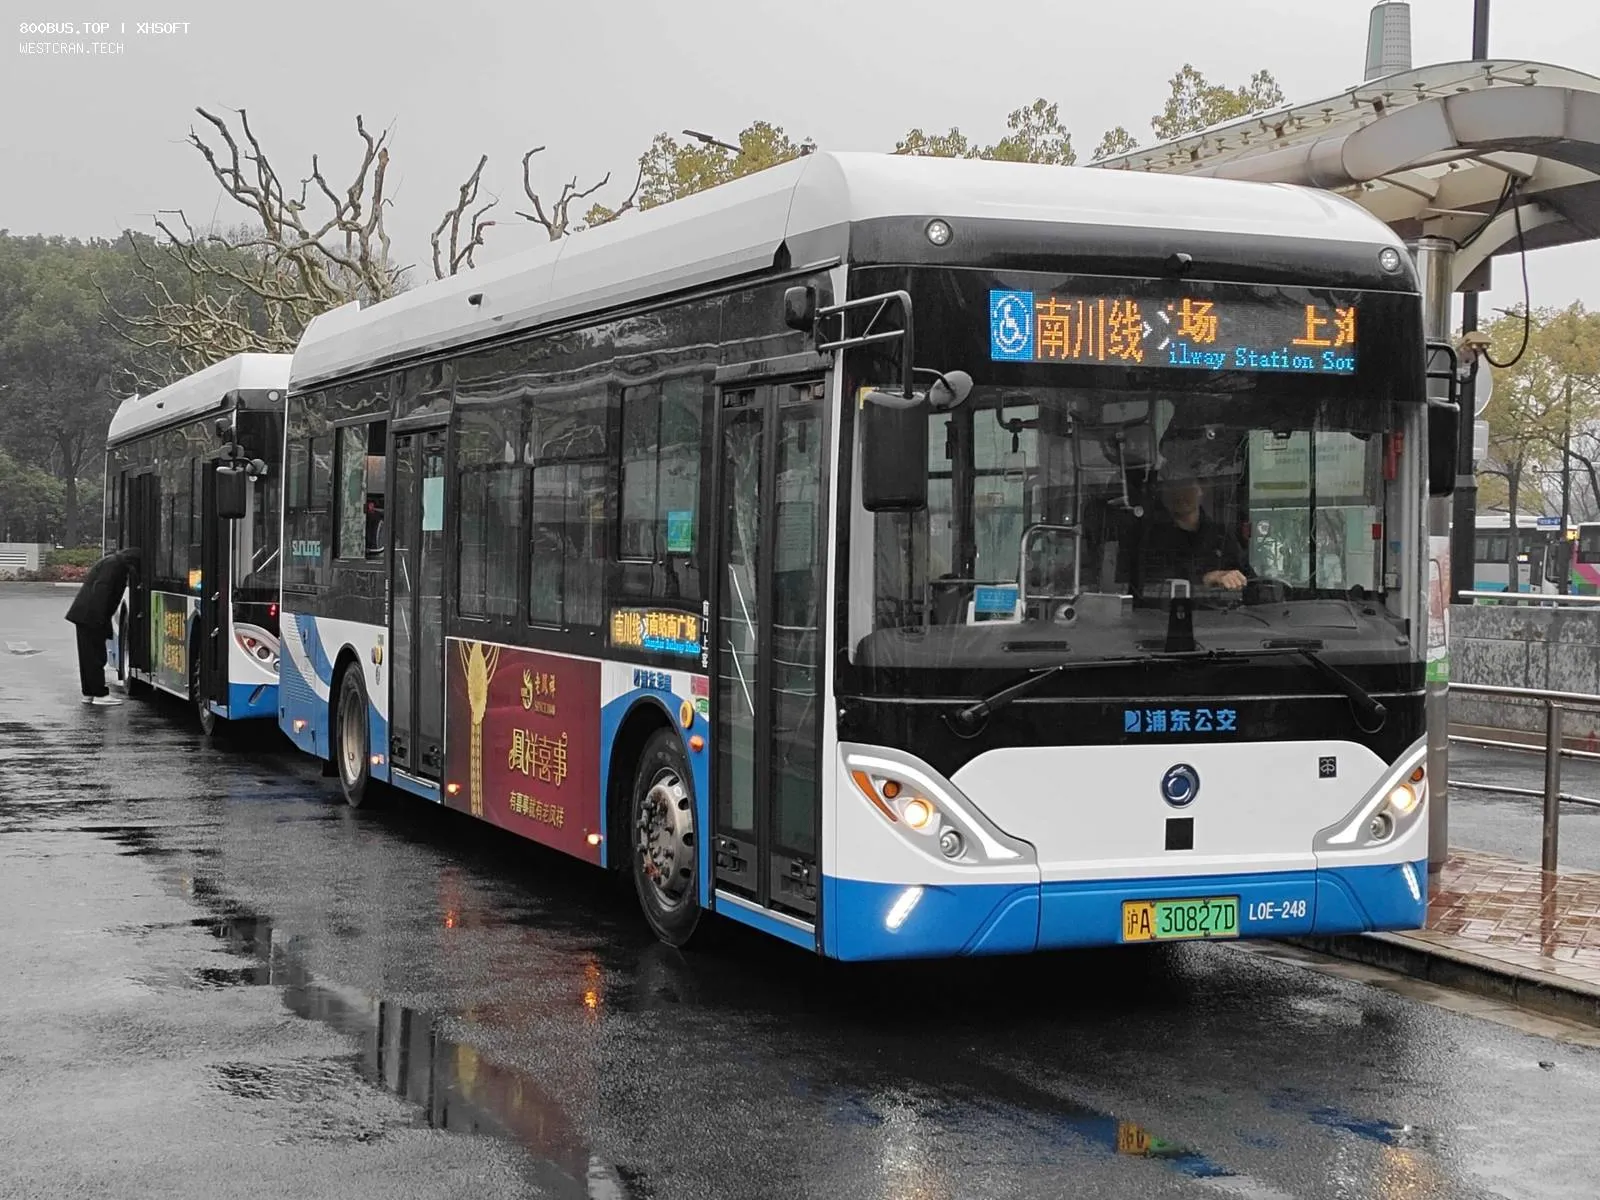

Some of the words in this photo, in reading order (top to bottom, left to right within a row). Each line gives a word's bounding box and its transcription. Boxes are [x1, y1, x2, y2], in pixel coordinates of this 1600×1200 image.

[1035, 296, 1144, 363] 南川线
[1177, 298, 1217, 343] 场
[1235, 347, 1314, 369] Station
[1146, 709, 1237, 732] 浦东公交
